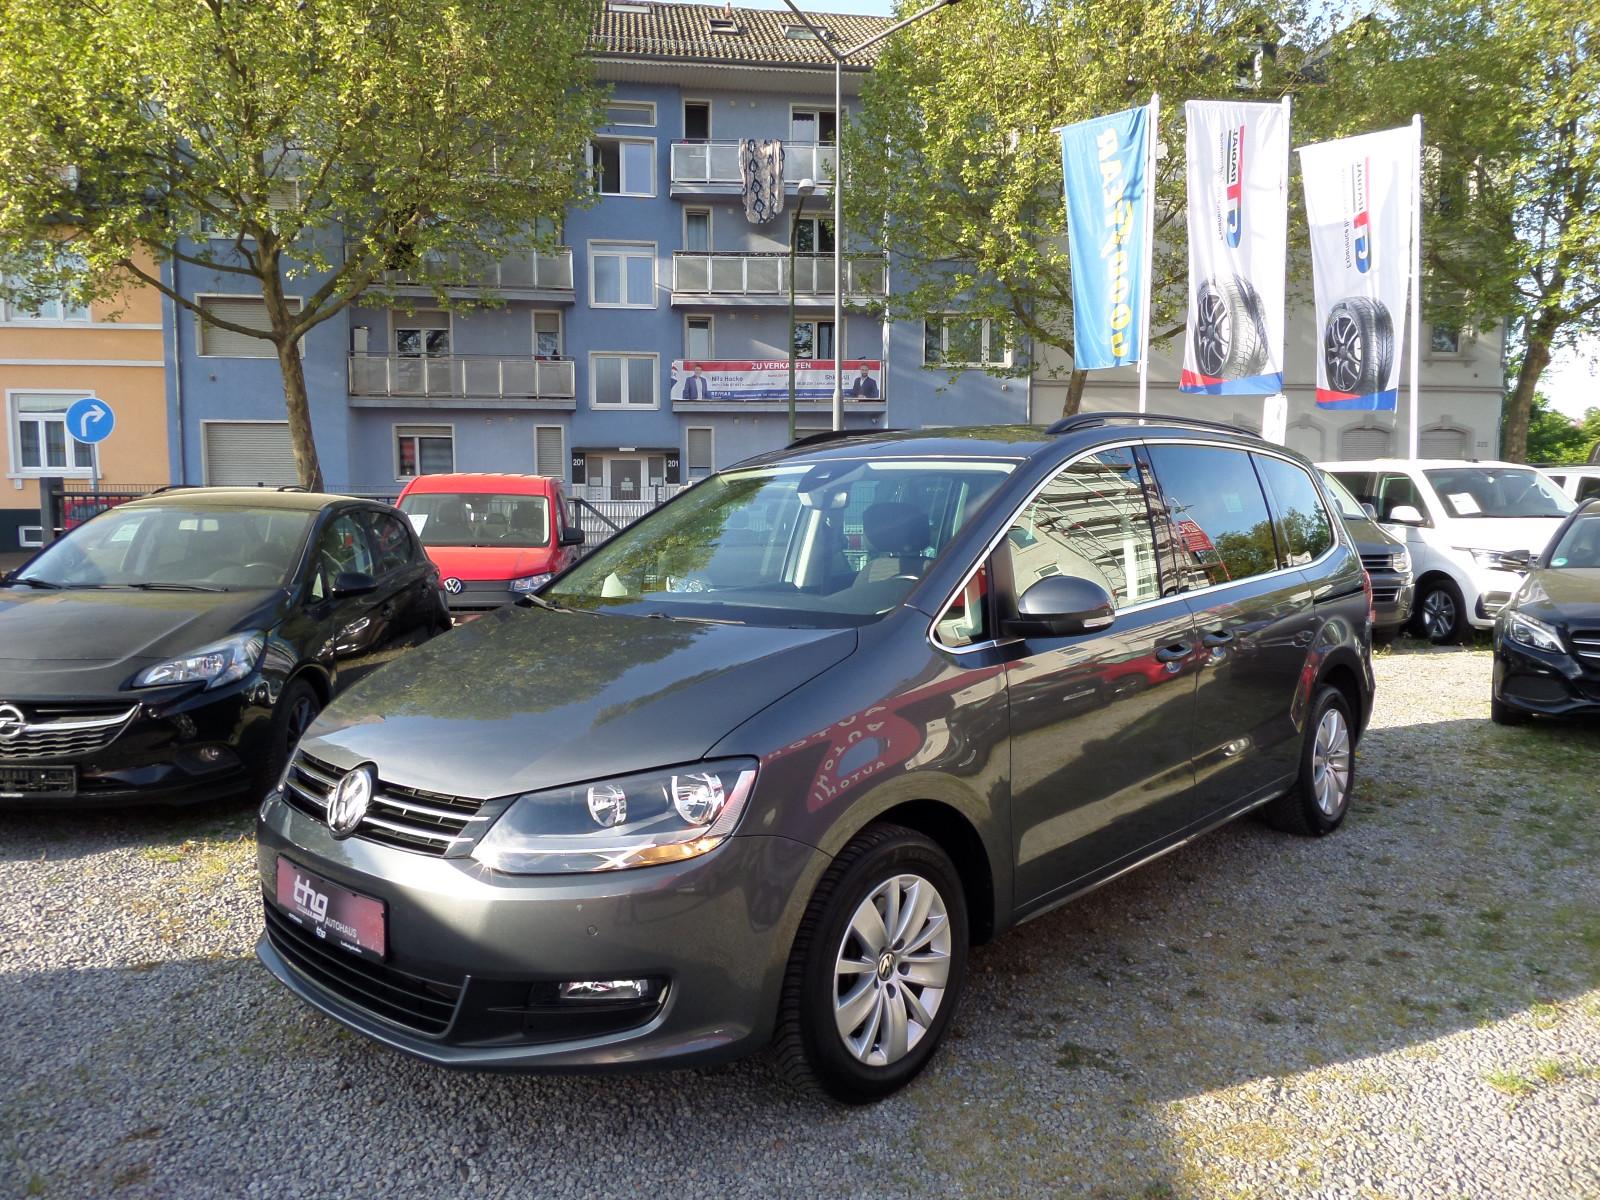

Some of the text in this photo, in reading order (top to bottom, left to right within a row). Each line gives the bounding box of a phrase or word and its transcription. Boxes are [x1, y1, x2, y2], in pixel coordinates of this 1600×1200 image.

[752, 361, 811, 370] ZU VERKAFEN
[573, 458, 584, 466] 201
[667, 460, 679, 468] 201
[324, 916, 358, 938] AUTOHAUS
